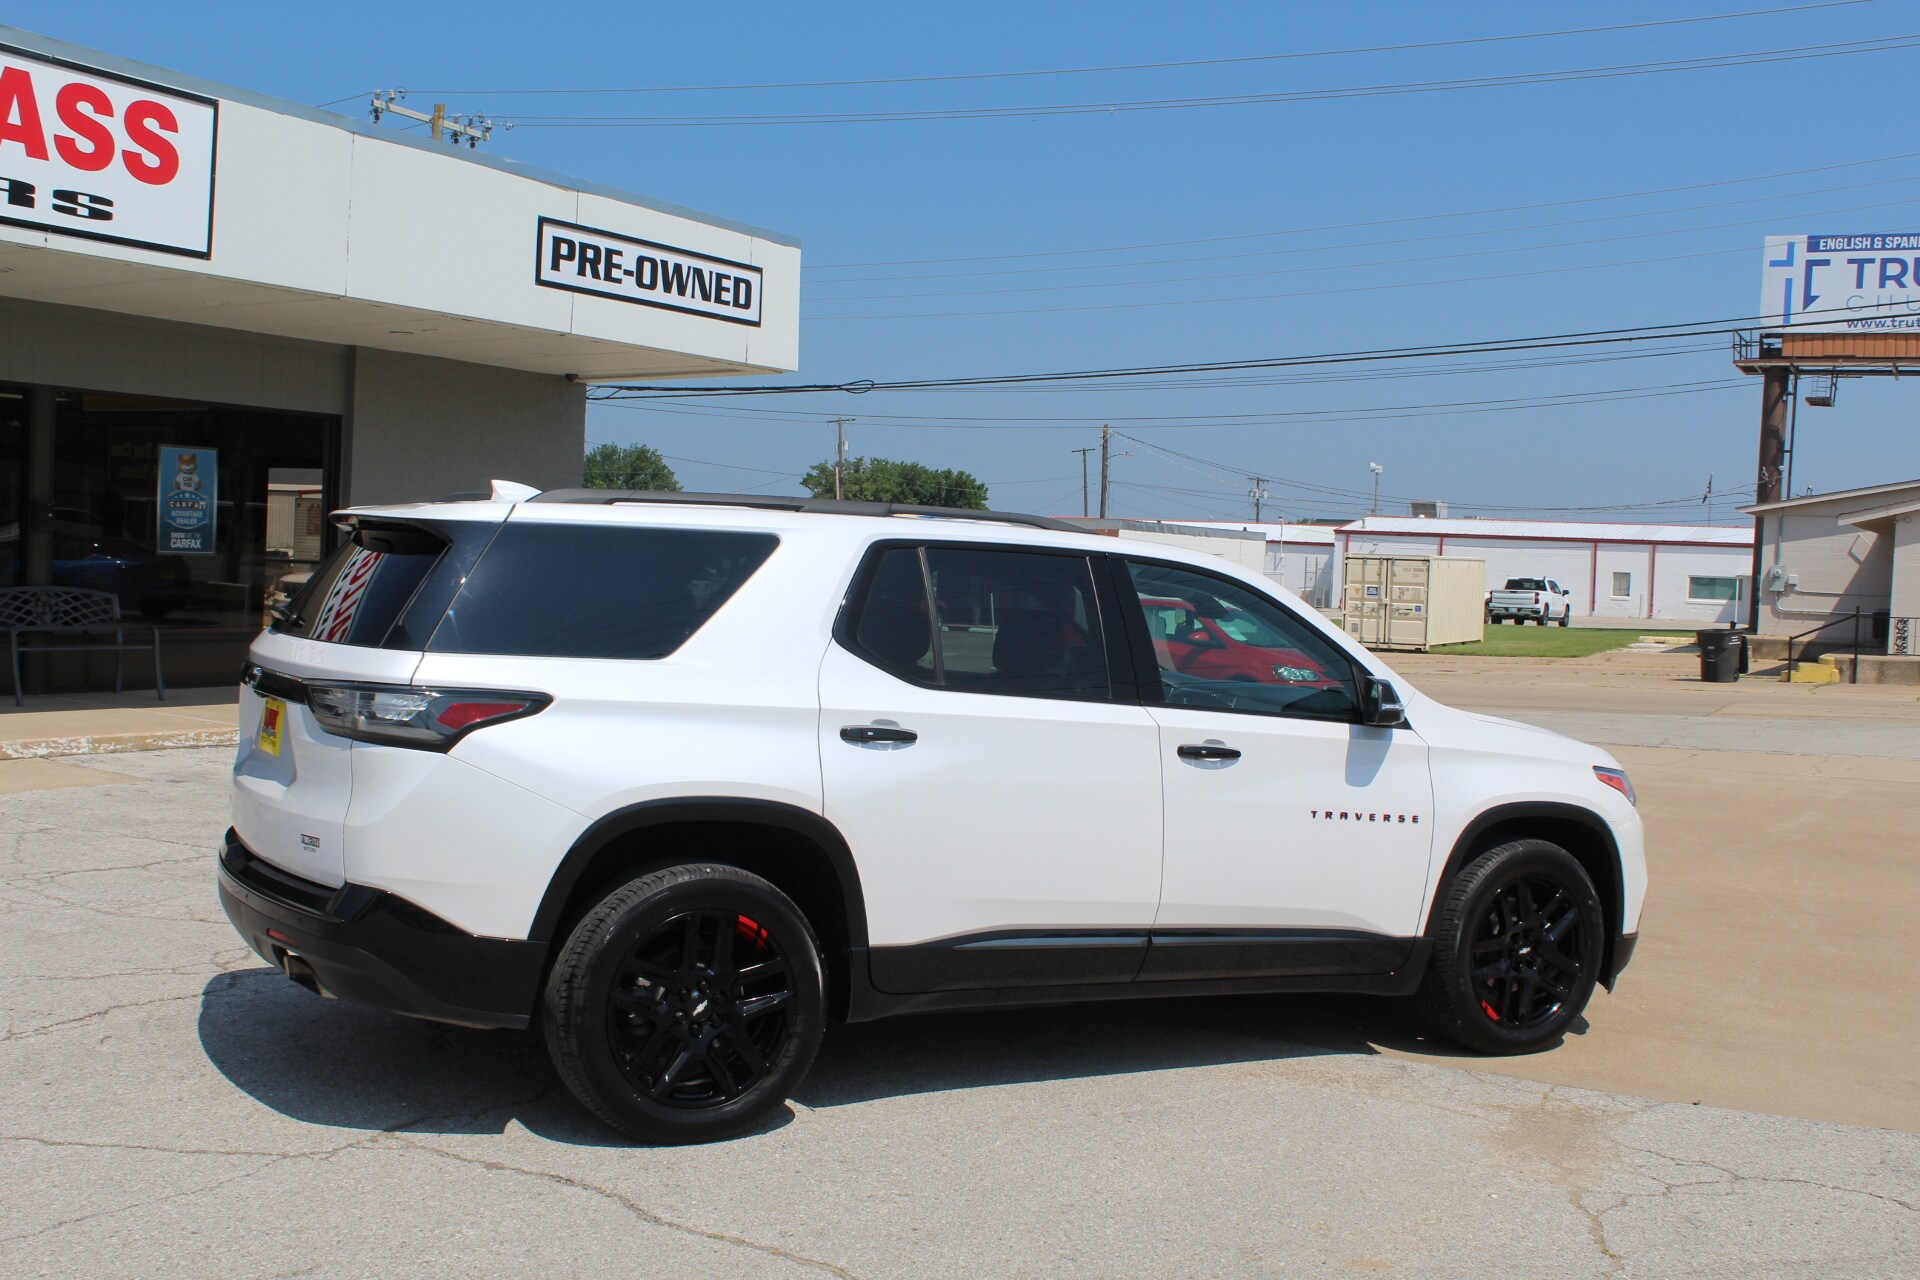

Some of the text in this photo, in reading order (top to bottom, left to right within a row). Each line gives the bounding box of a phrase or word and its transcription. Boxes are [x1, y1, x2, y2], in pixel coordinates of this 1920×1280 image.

[0, 65, 180, 186] ASS
[1819, 237, 1871, 250] ENGLISH
[1873, 236, 1882, 249] &
[550, 235, 753, 311] PRE-OWNED
[169, 501, 206, 510] CARFAX
[170, 538, 202, 549] CARFAX
[1310, 810, 1420, 824] TRAVERSE
